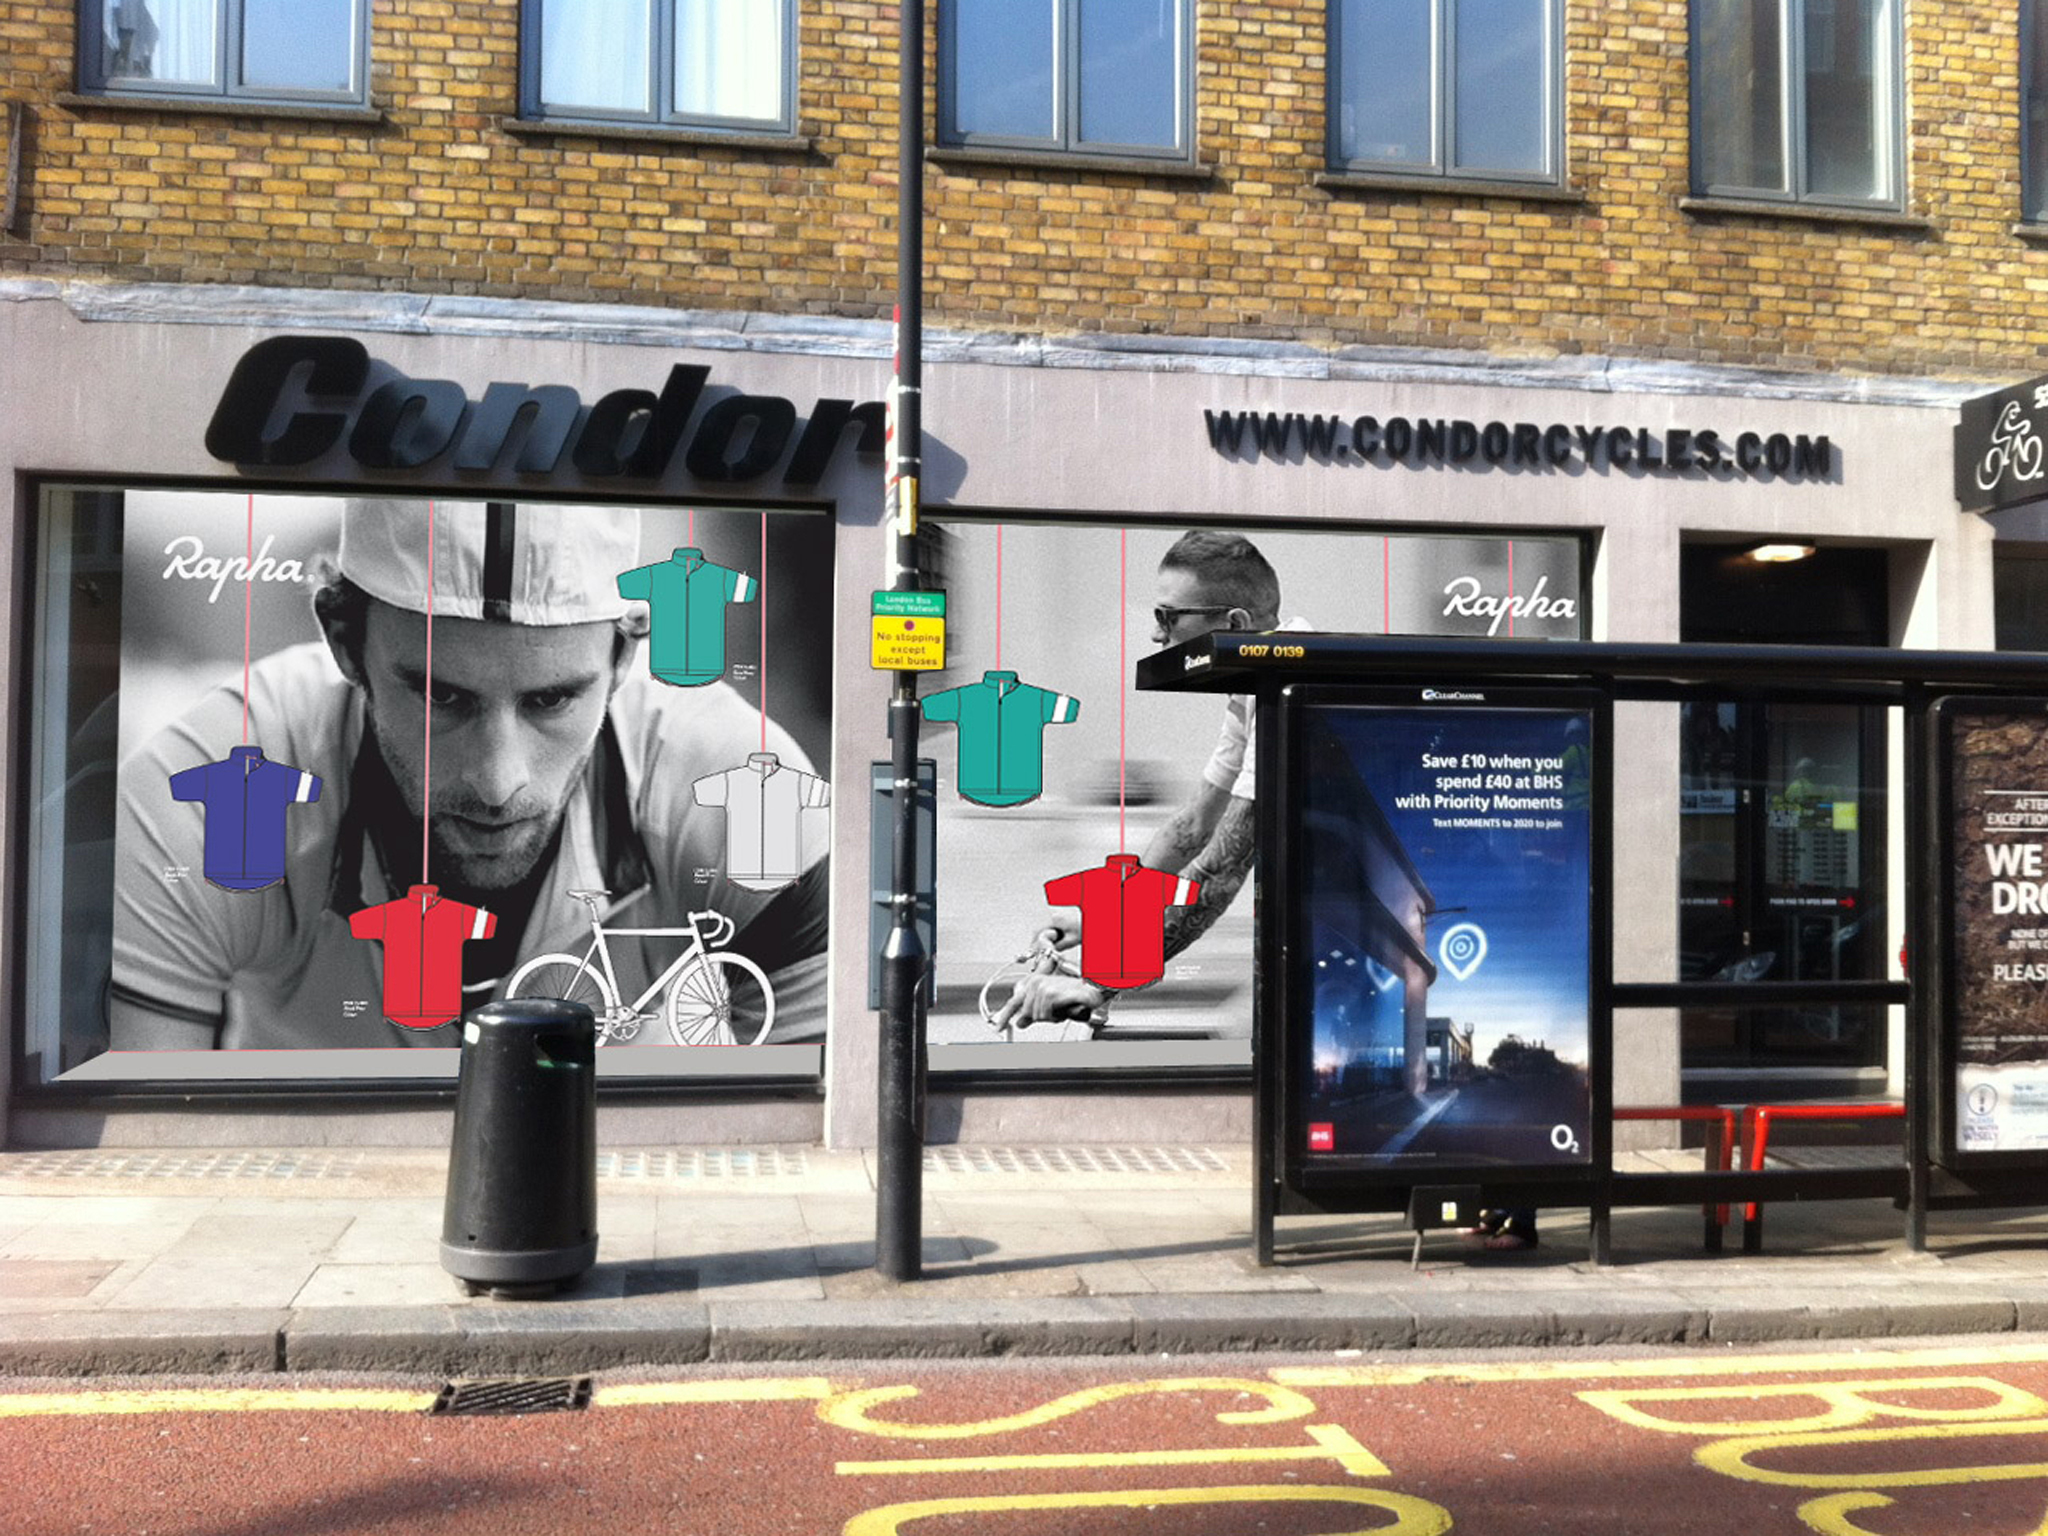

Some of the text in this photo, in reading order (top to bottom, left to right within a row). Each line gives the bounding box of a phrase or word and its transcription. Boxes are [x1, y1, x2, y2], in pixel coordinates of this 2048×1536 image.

[204, 335, 887, 485] Condor
[1205, 409, 1831, 477] WWW.CONDORCYCLES.COM
[1443, 575, 1577, 637] Rapha
[876, 632, 941, 644] No stopping
[890, 645, 926, 655] except
[1239, 644, 1304, 658] 0107 0139
[878, 655, 938, 666] local buses
[1421, 753, 1563, 773] Save £10 when you
[1435, 774, 1563, 791] spend £40 at BHS
[1395, 793, 1563, 813] with Priority Moments
[1433, 818, 1563, 830] Text MOMENTS to 2020 to join
[1984, 843, 2043, 877] WE
